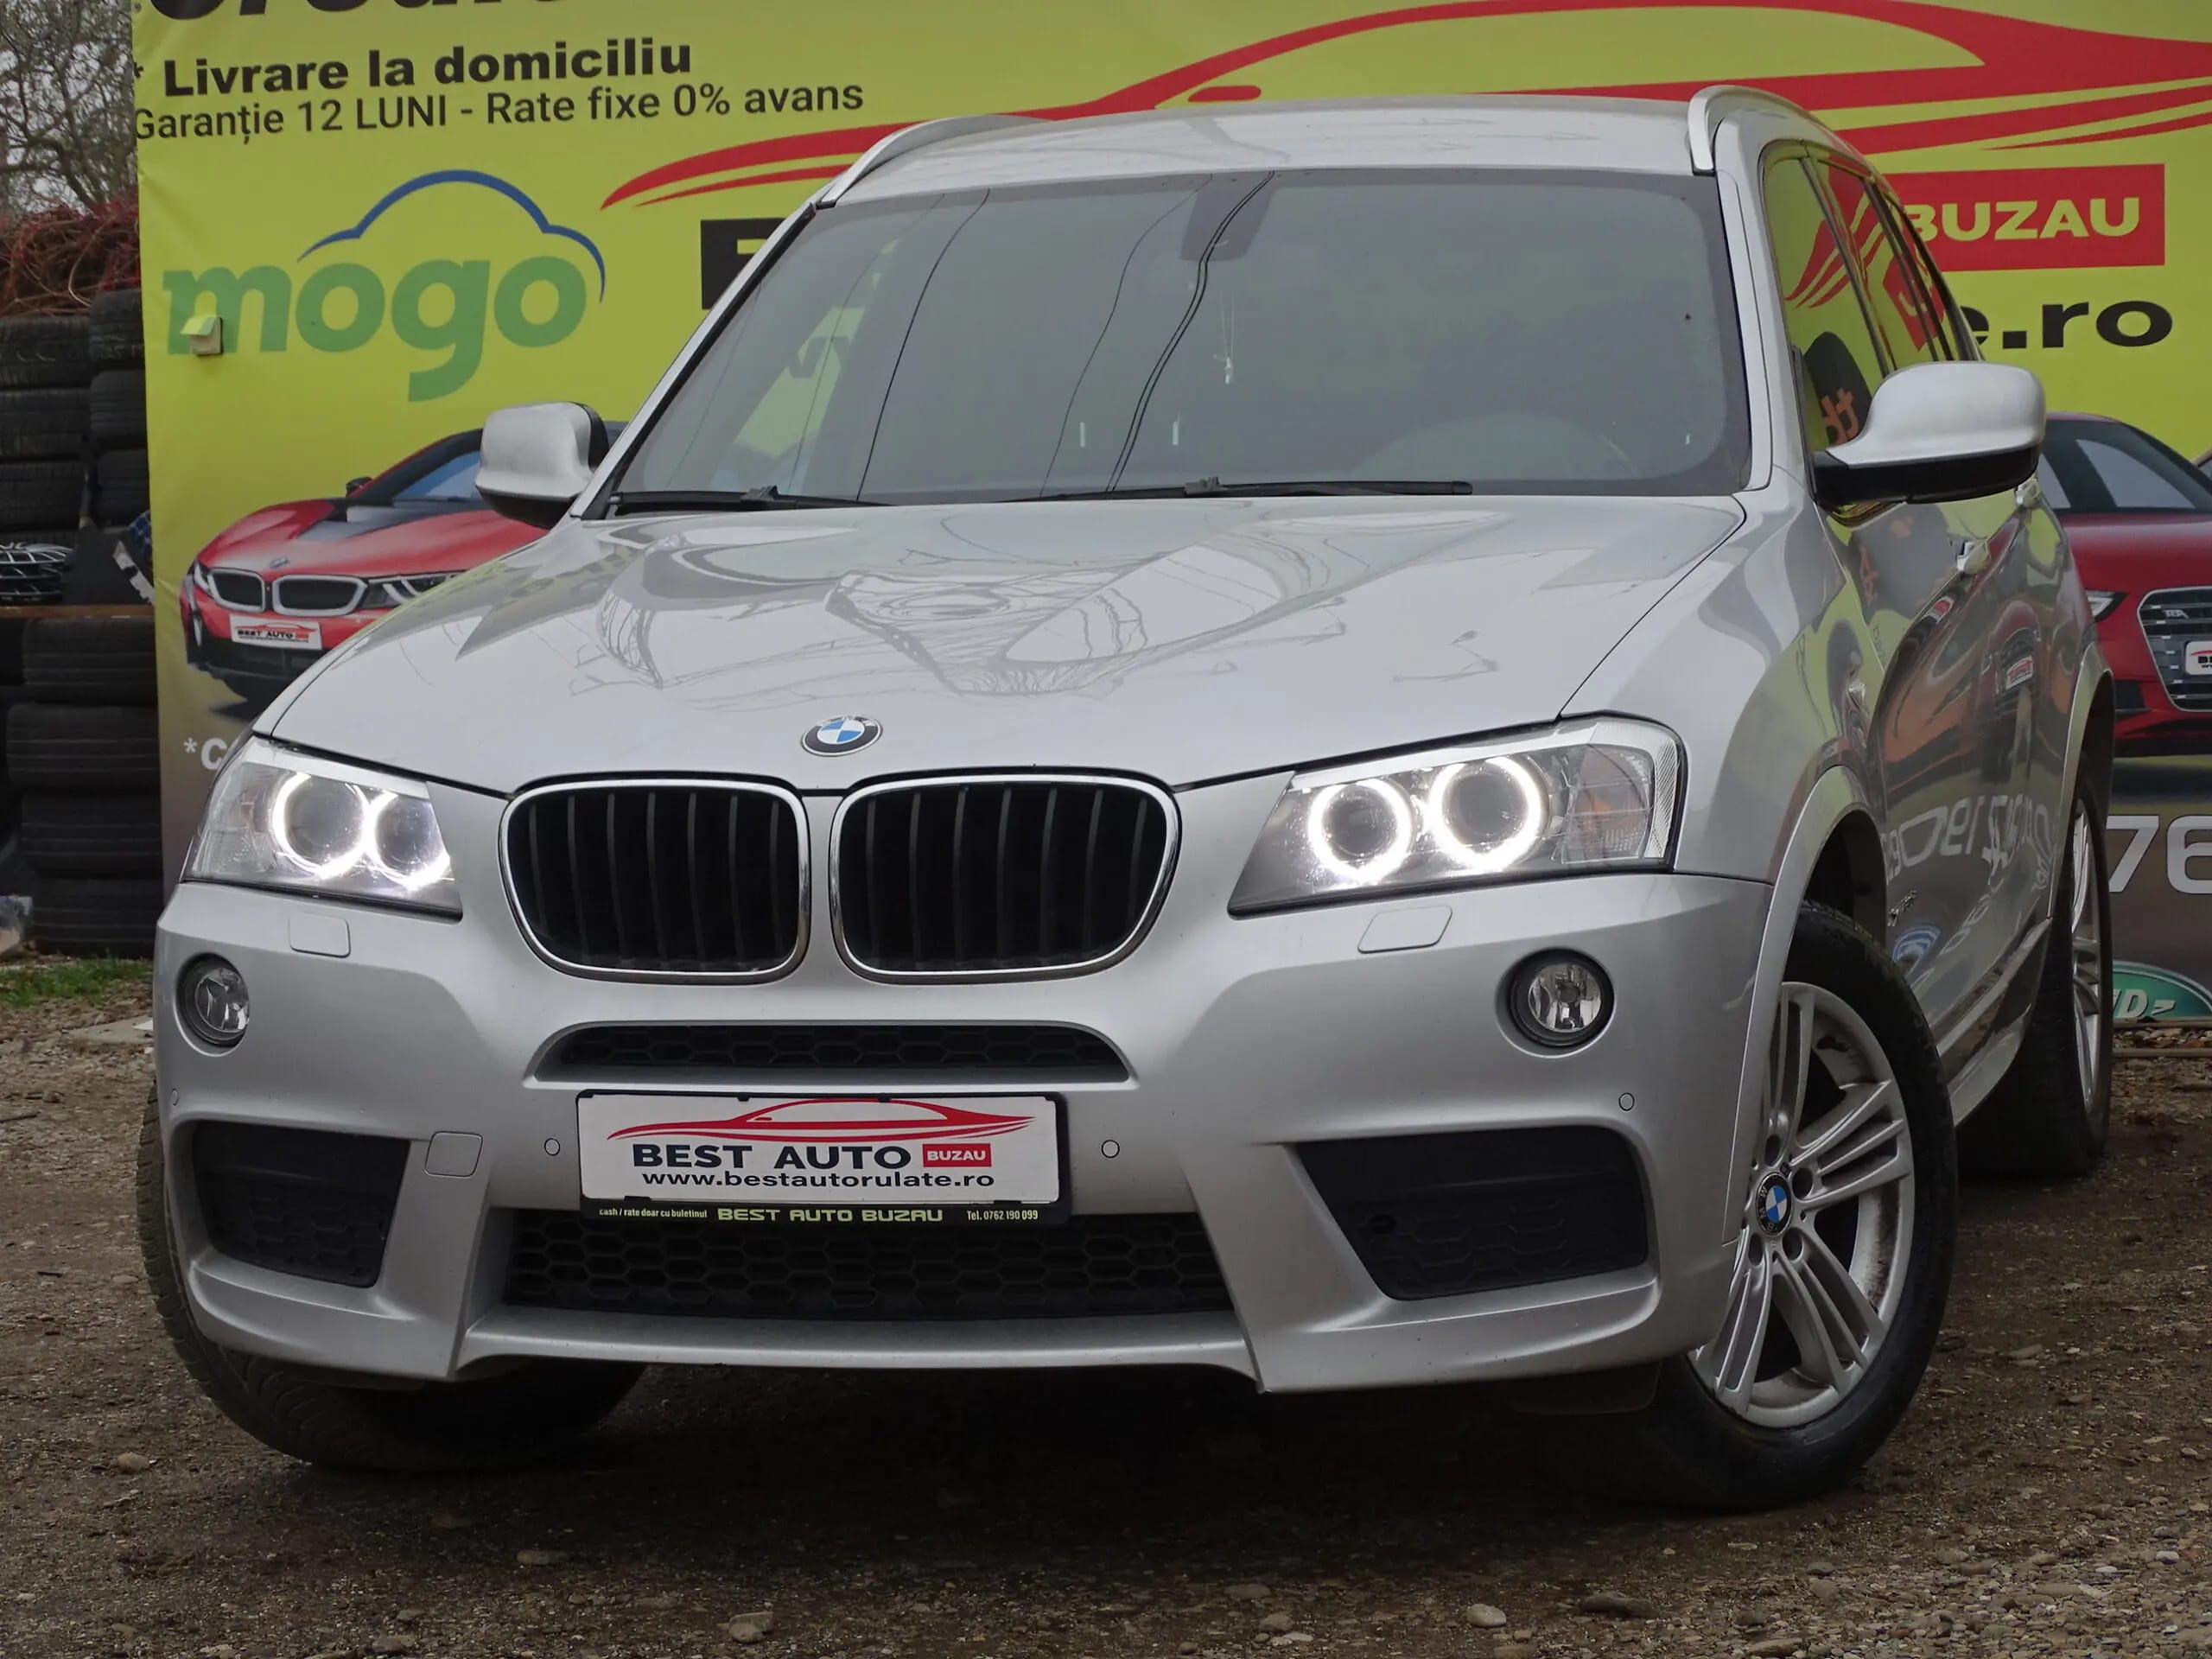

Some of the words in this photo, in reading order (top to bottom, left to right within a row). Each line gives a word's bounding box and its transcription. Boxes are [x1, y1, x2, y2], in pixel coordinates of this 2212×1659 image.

[164, 58, 349, 97] Livrare
[369, 49, 415, 87] la
[434, 37, 691, 84] domiciliu
[135, 102, 284, 144] Garanție
[298, 99, 343, 132] 12
[356, 94, 447, 129] LUNI
[486, 89, 575, 124] Rate
[588, 85, 660, 120] fixe
[674, 83, 731, 117] 0%
[744, 85, 864, 113] avans
[1904, 197, 2140, 243] BUZAU
[162, 256, 588, 403] mogo
[632, 1143, 753, 1168] BEST
[774, 1145, 912, 1169] AUTO
[927, 1150, 987, 1161] BUZAU
[642, 1171, 995, 1187] www.bestautorulate.ro
[641, 1208, 658, 1217] doar
[671, 1209, 708, 1218] buletinul
[717, 1208, 780, 1221] BEST
[790, 1209, 853, 1222] AUTO
[861, 1210, 944, 1222] BUZAU
[967, 1211, 982, 1220] Tel.
[983, 1211, 1005, 1220] 0762
[1006, 1211, 1020, 1220] 190
[1021, 1210, 1039, 1220] 099
